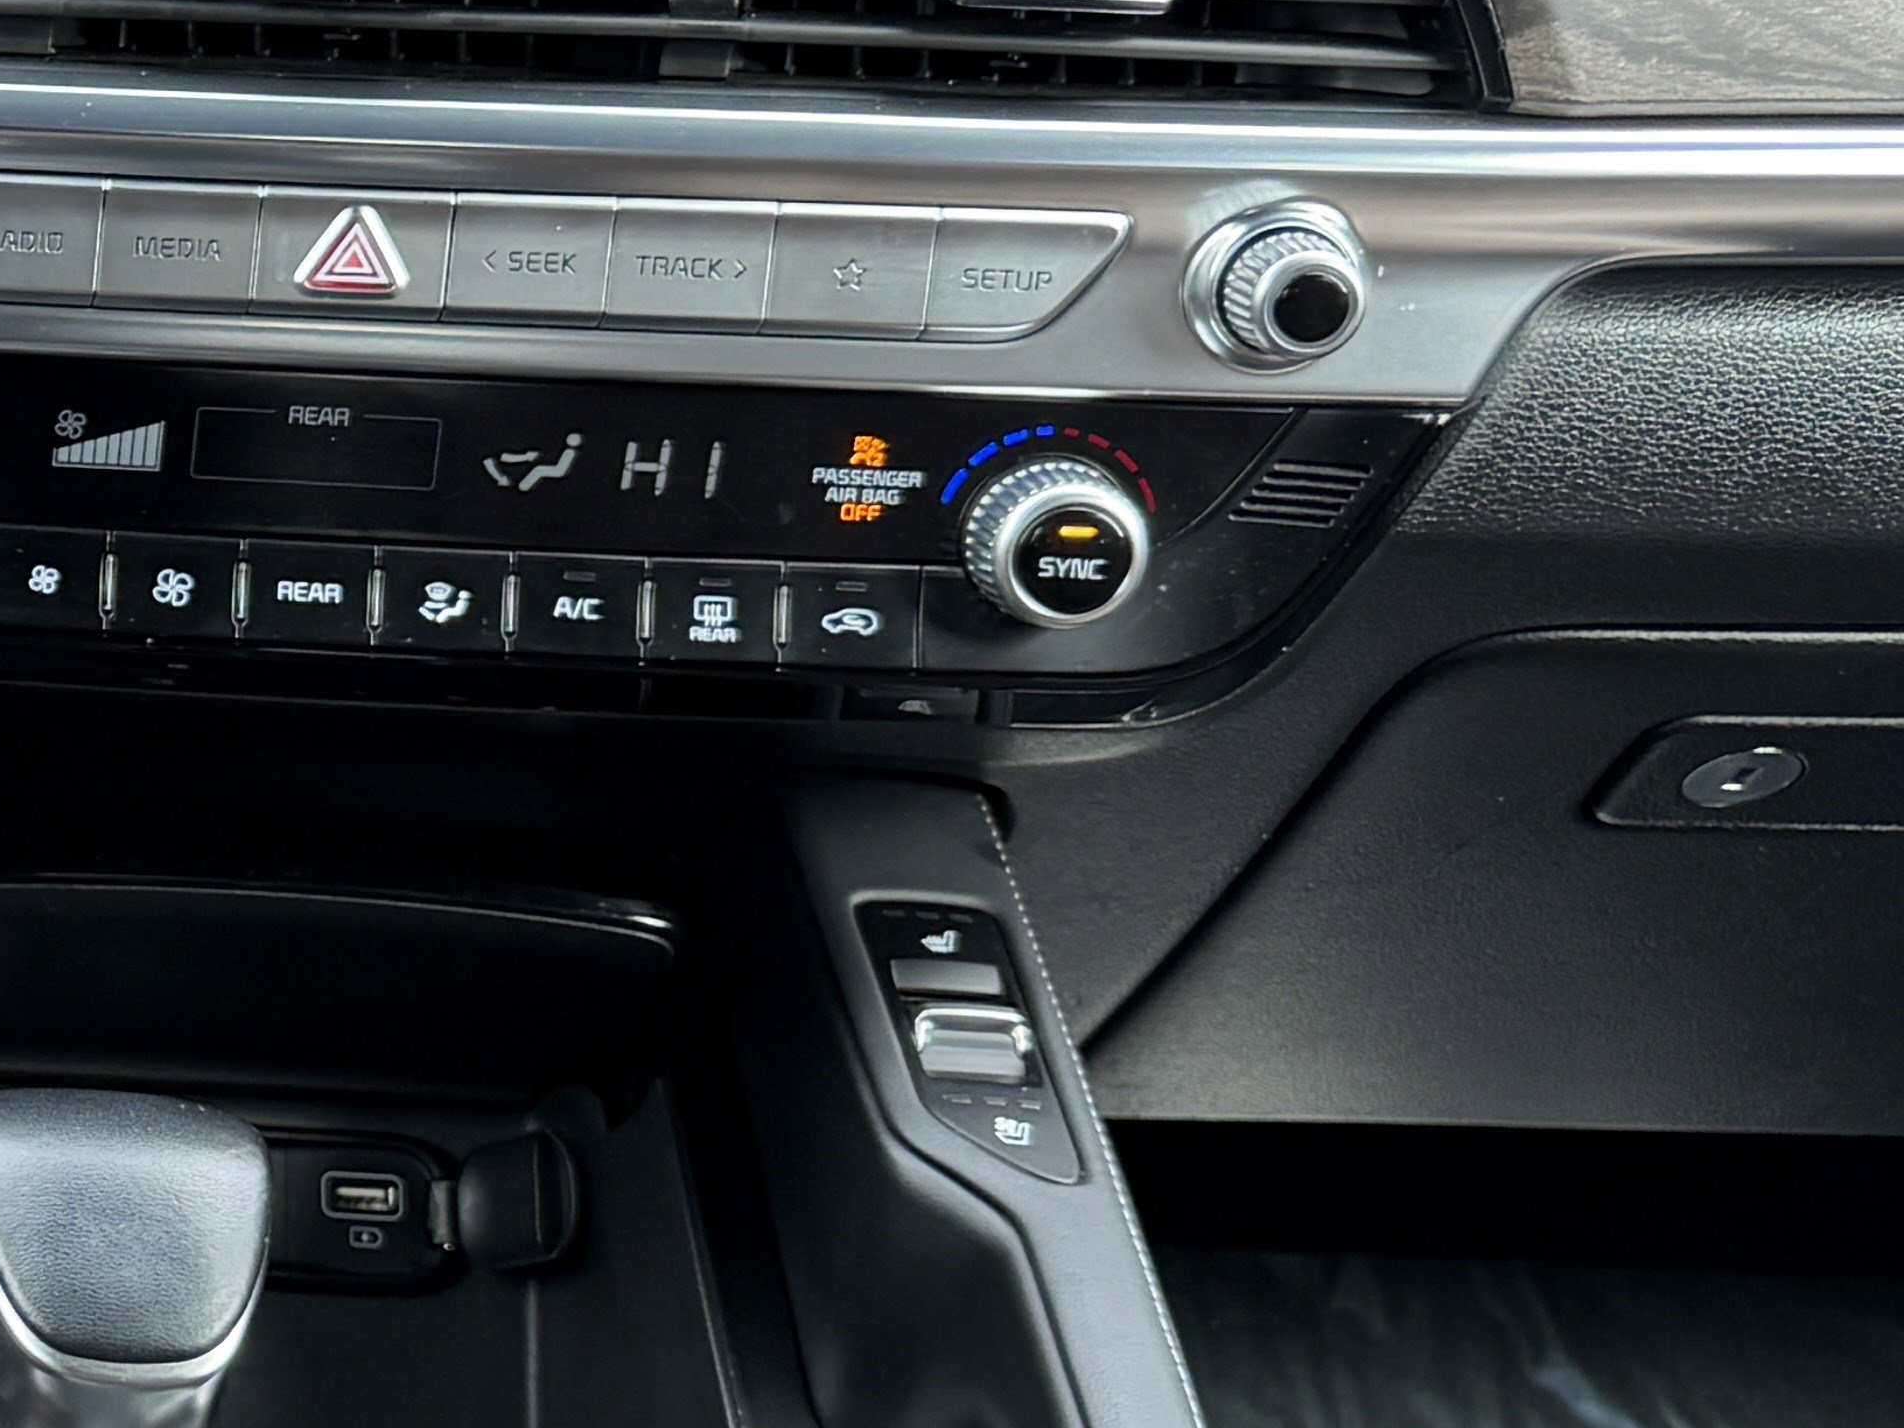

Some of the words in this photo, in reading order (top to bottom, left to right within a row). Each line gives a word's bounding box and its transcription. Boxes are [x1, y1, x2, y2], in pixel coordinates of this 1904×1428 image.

[133, 235, 221, 262] MEDIA
[508, 249, 577, 275] SEEK
[635, 254, 723, 280] TRACK
[961, 267, 1053, 293] SETUP
[288, 405, 351, 427] REAR
[811, 466, 924, 489] PASSENGER
[824, 486, 858, 503] AIR
[861, 488, 901, 506] BAG
[840, 503, 884, 522] OFF
[1037, 556, 1107, 582] SYNC
[276, 580, 344, 605] REAR
[552, 596, 604, 622] A/C
[688, 625, 737, 643] REAR
